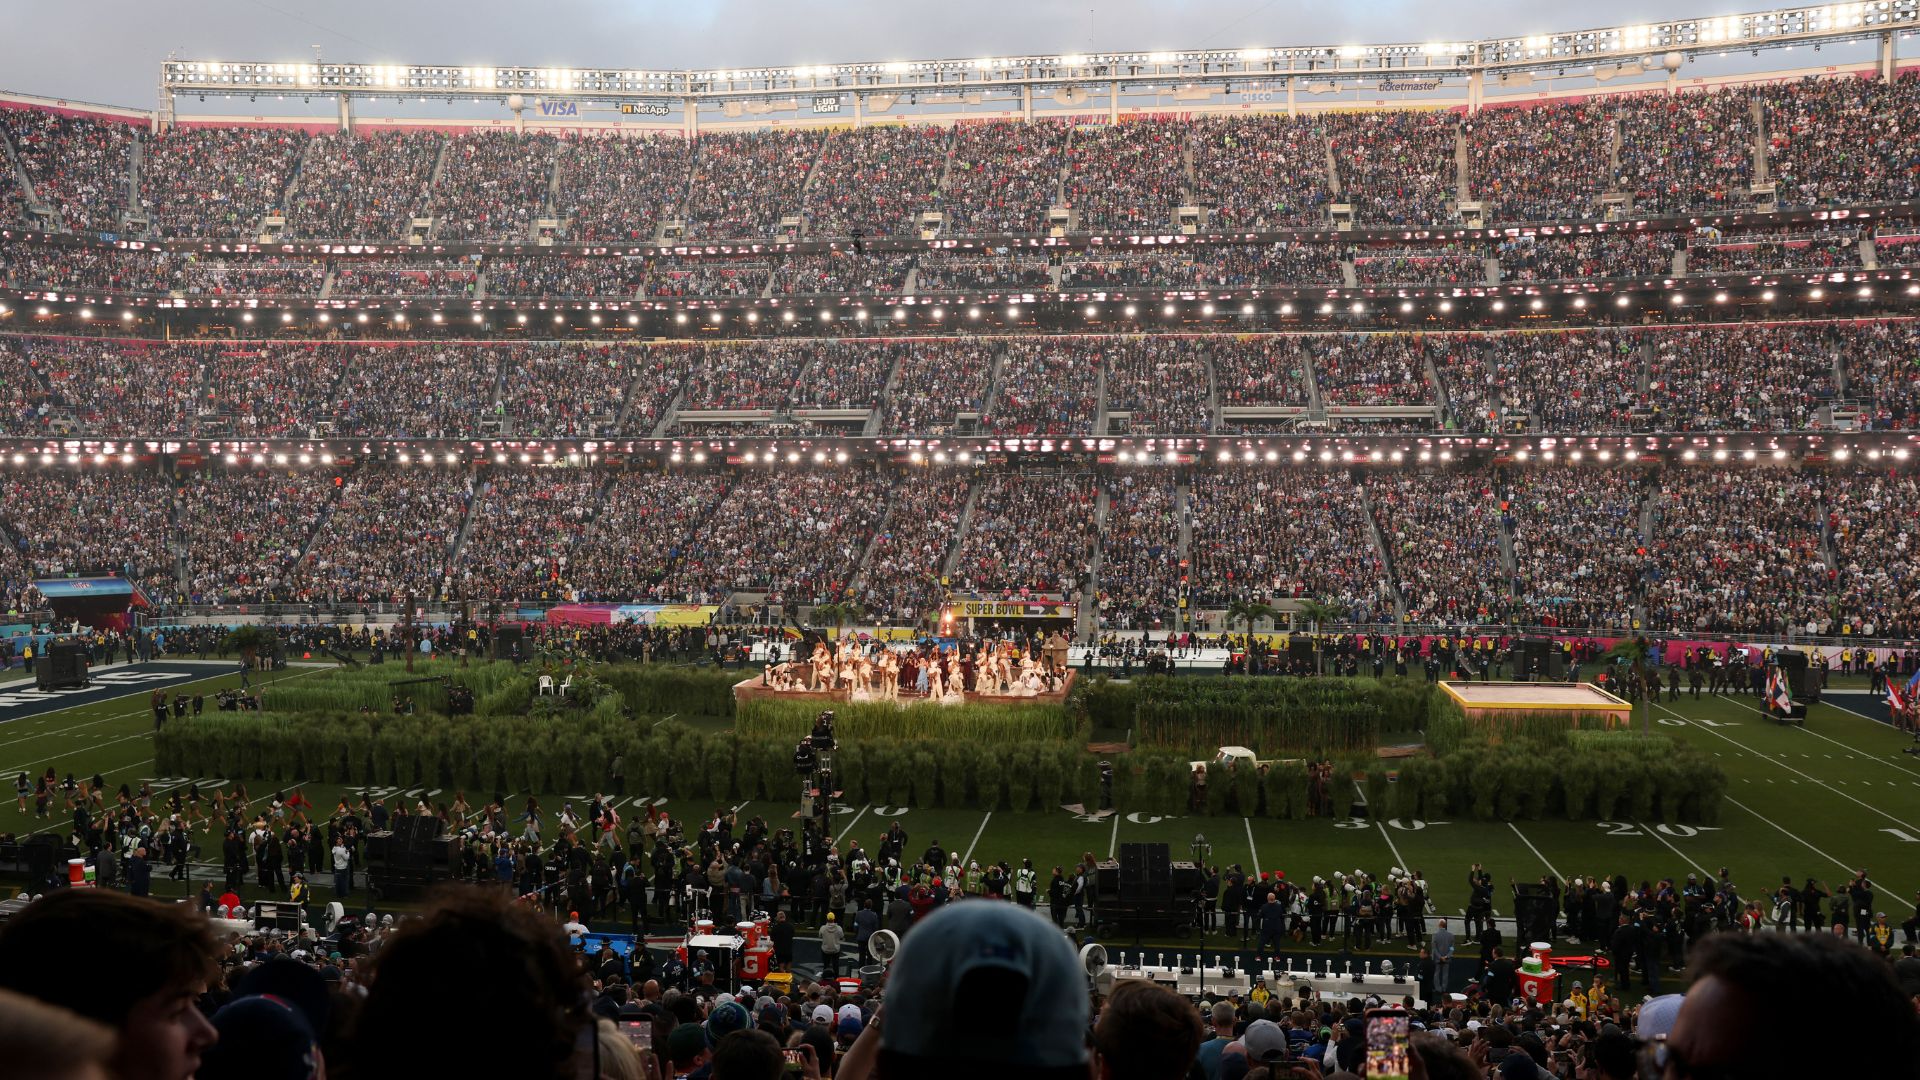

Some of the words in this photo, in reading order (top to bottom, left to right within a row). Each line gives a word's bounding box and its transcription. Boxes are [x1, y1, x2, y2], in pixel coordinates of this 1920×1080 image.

[1379, 81, 1437, 91] ticketmaster
[1241, 93, 1271, 101] CISCO
[541, 101, 578, 115] VISA
[633, 105, 669, 115] NetApp
[966, 603, 994, 615] SUPER
[996, 603, 1021, 615] BOWL
[1597, 821, 1698, 837] 20
[742, 955, 759, 974] G
[1523, 980, 1538, 996] G
